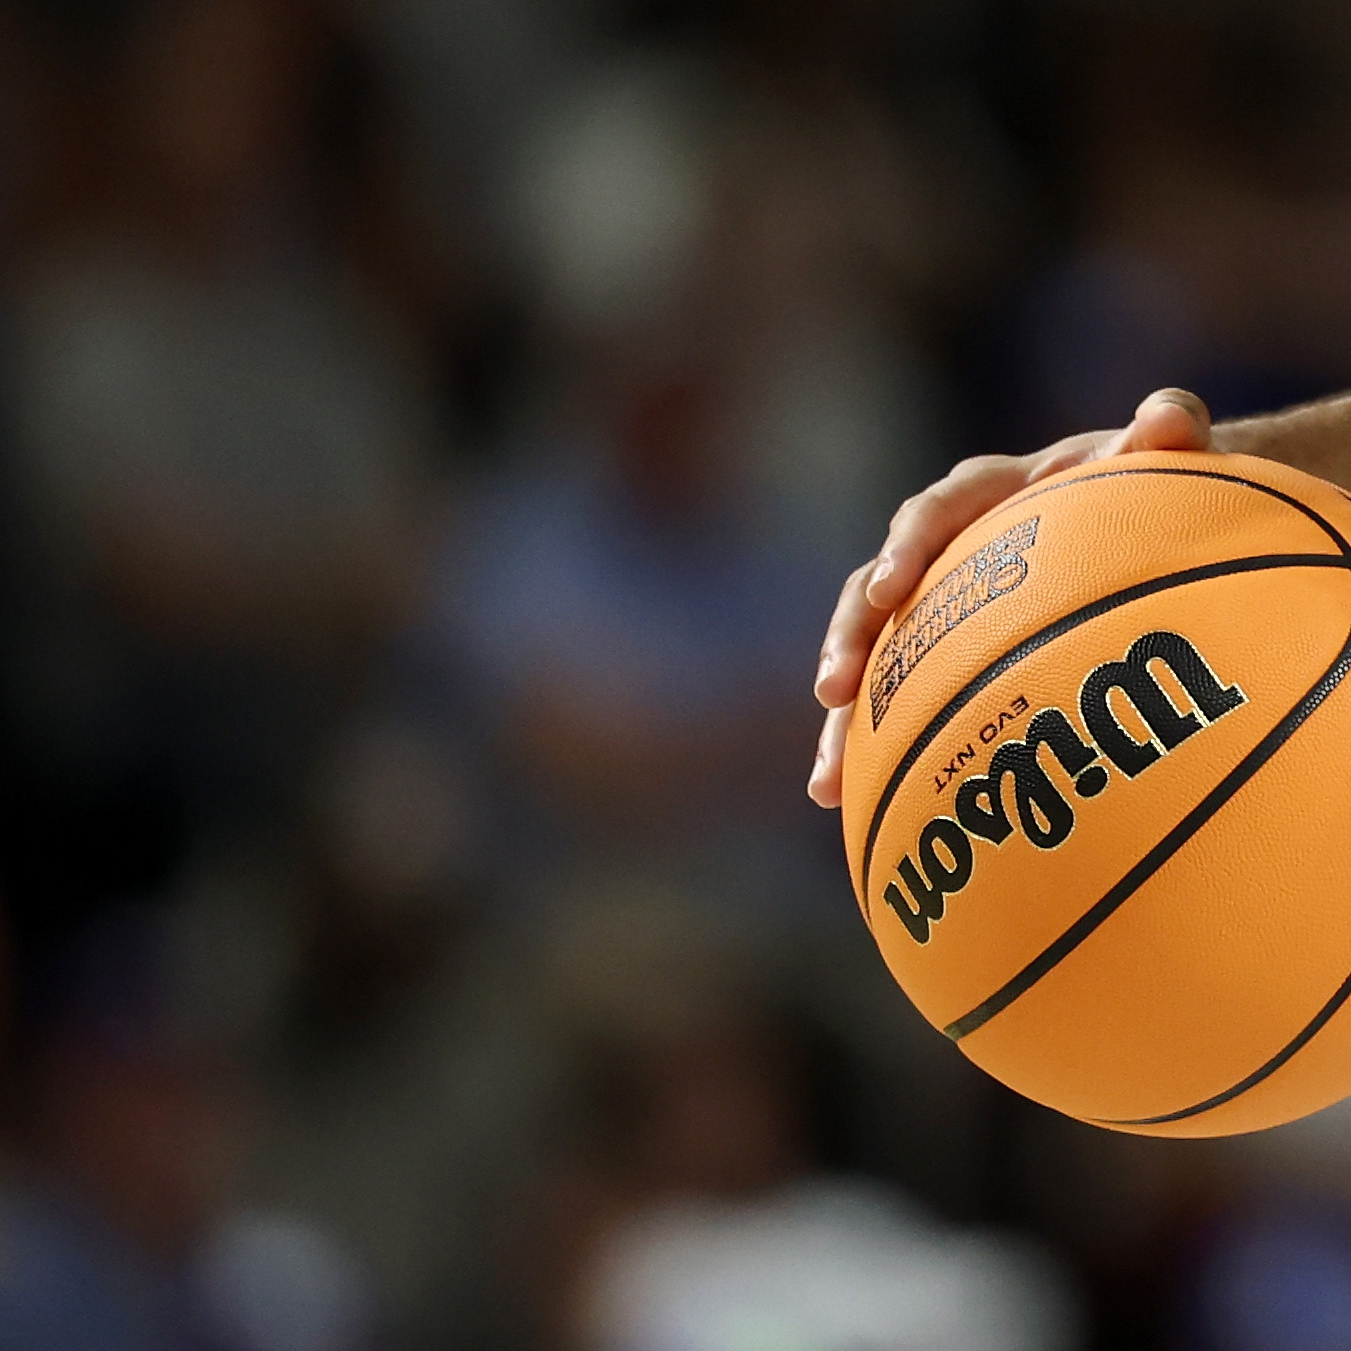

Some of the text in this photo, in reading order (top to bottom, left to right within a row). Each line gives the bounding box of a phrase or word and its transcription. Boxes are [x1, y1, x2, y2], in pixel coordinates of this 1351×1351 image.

[883, 629, 1250, 947] Wilson
[935, 695, 1030, 794] EVO NXT
